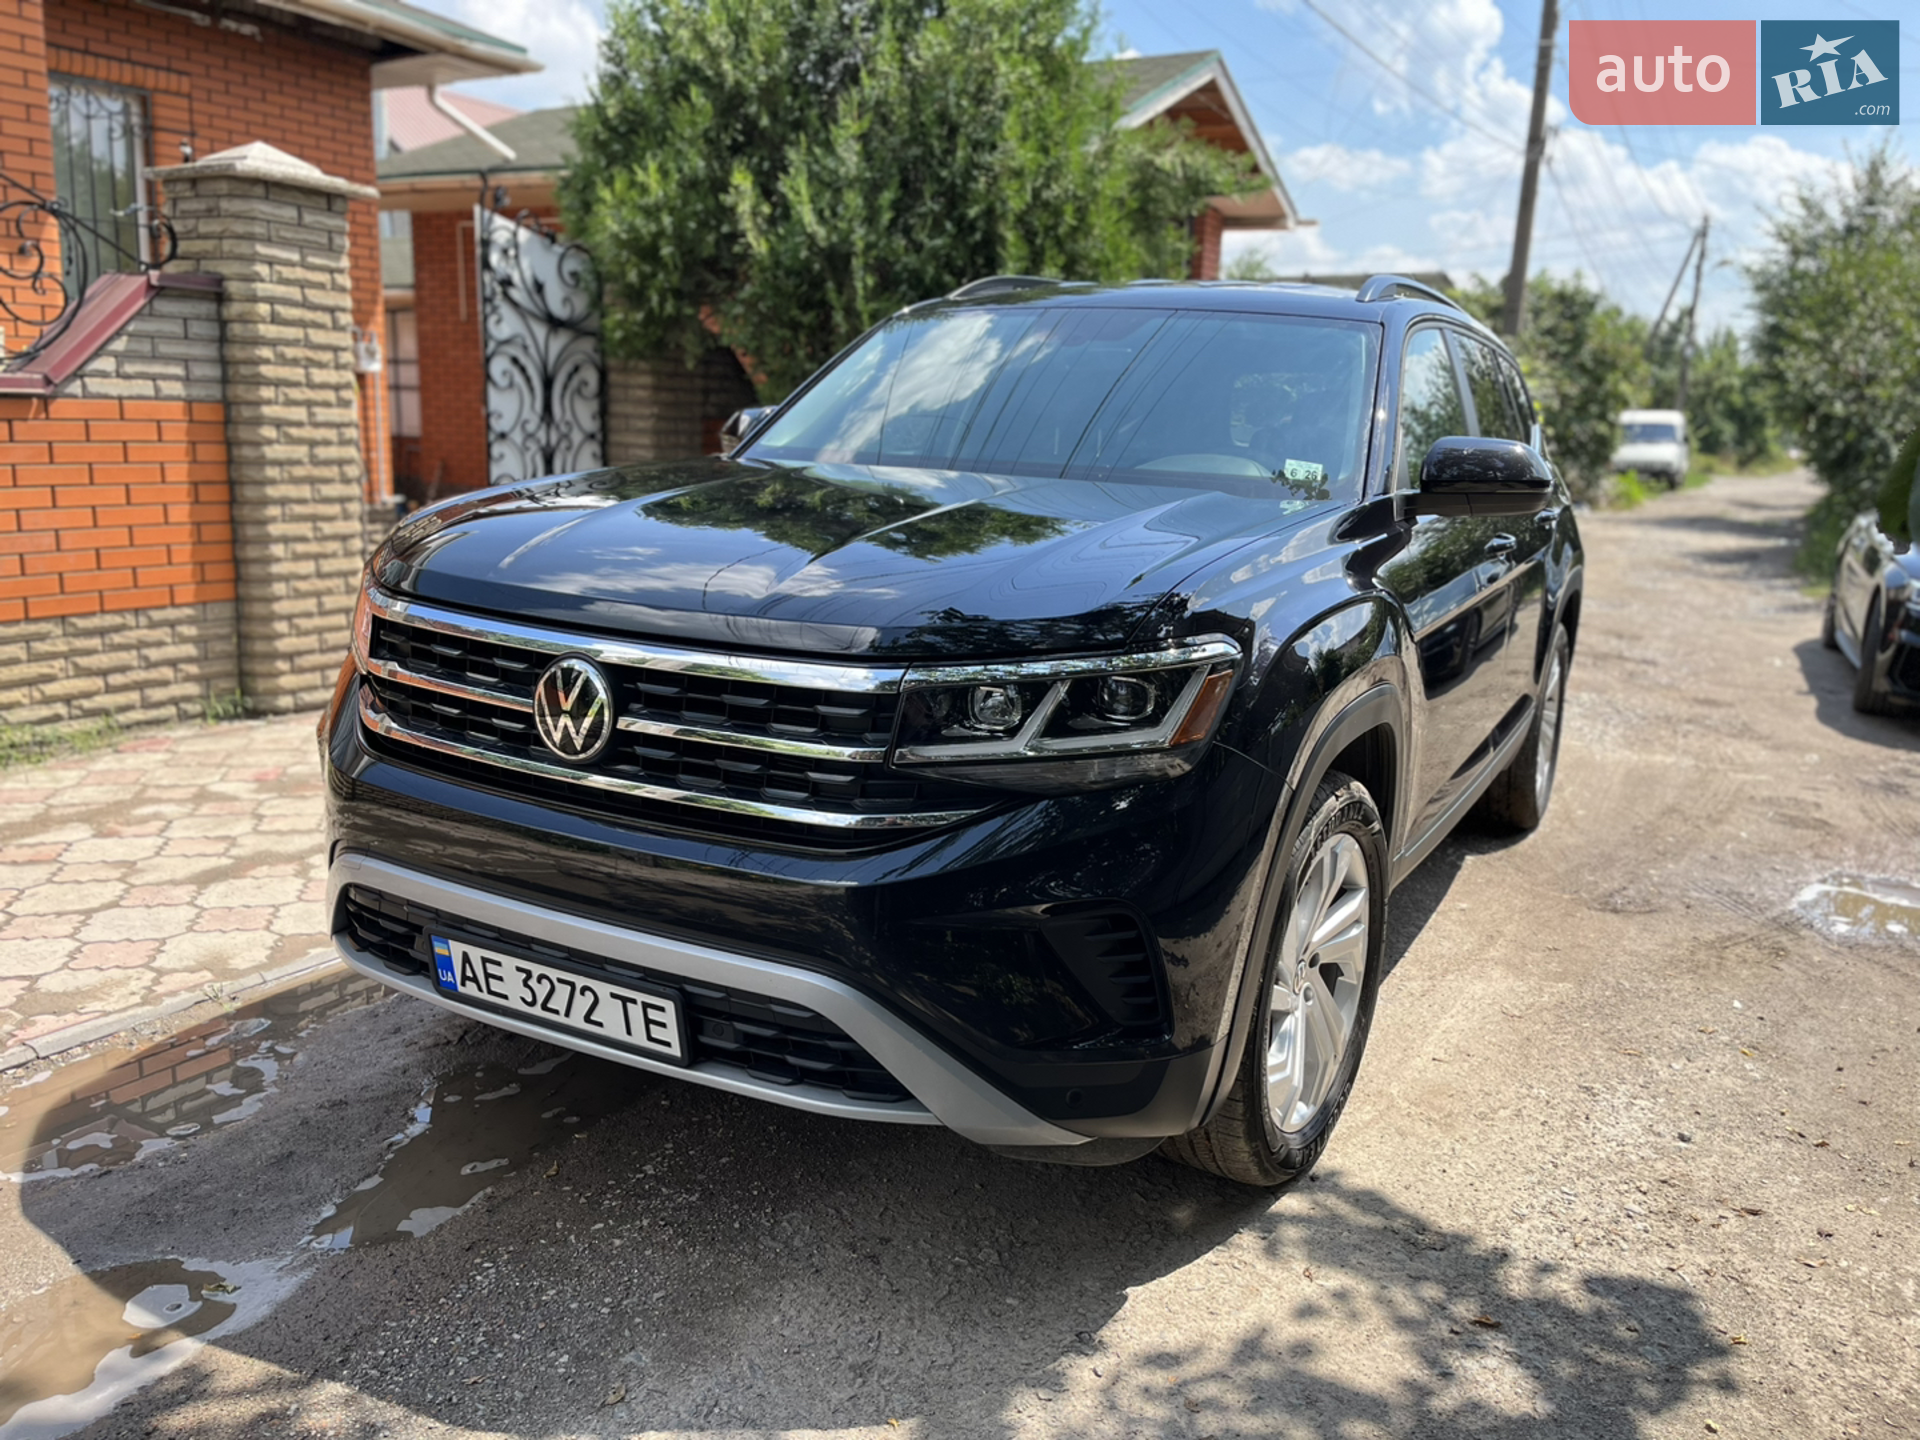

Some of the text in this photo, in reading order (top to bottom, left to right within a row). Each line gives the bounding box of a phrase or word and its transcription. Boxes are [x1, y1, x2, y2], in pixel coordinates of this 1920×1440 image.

[1290, 468, 1318, 481] 6 26
[438, 968, 455, 984] UA
[460, 951, 672, 1048] AE 3272 TE
